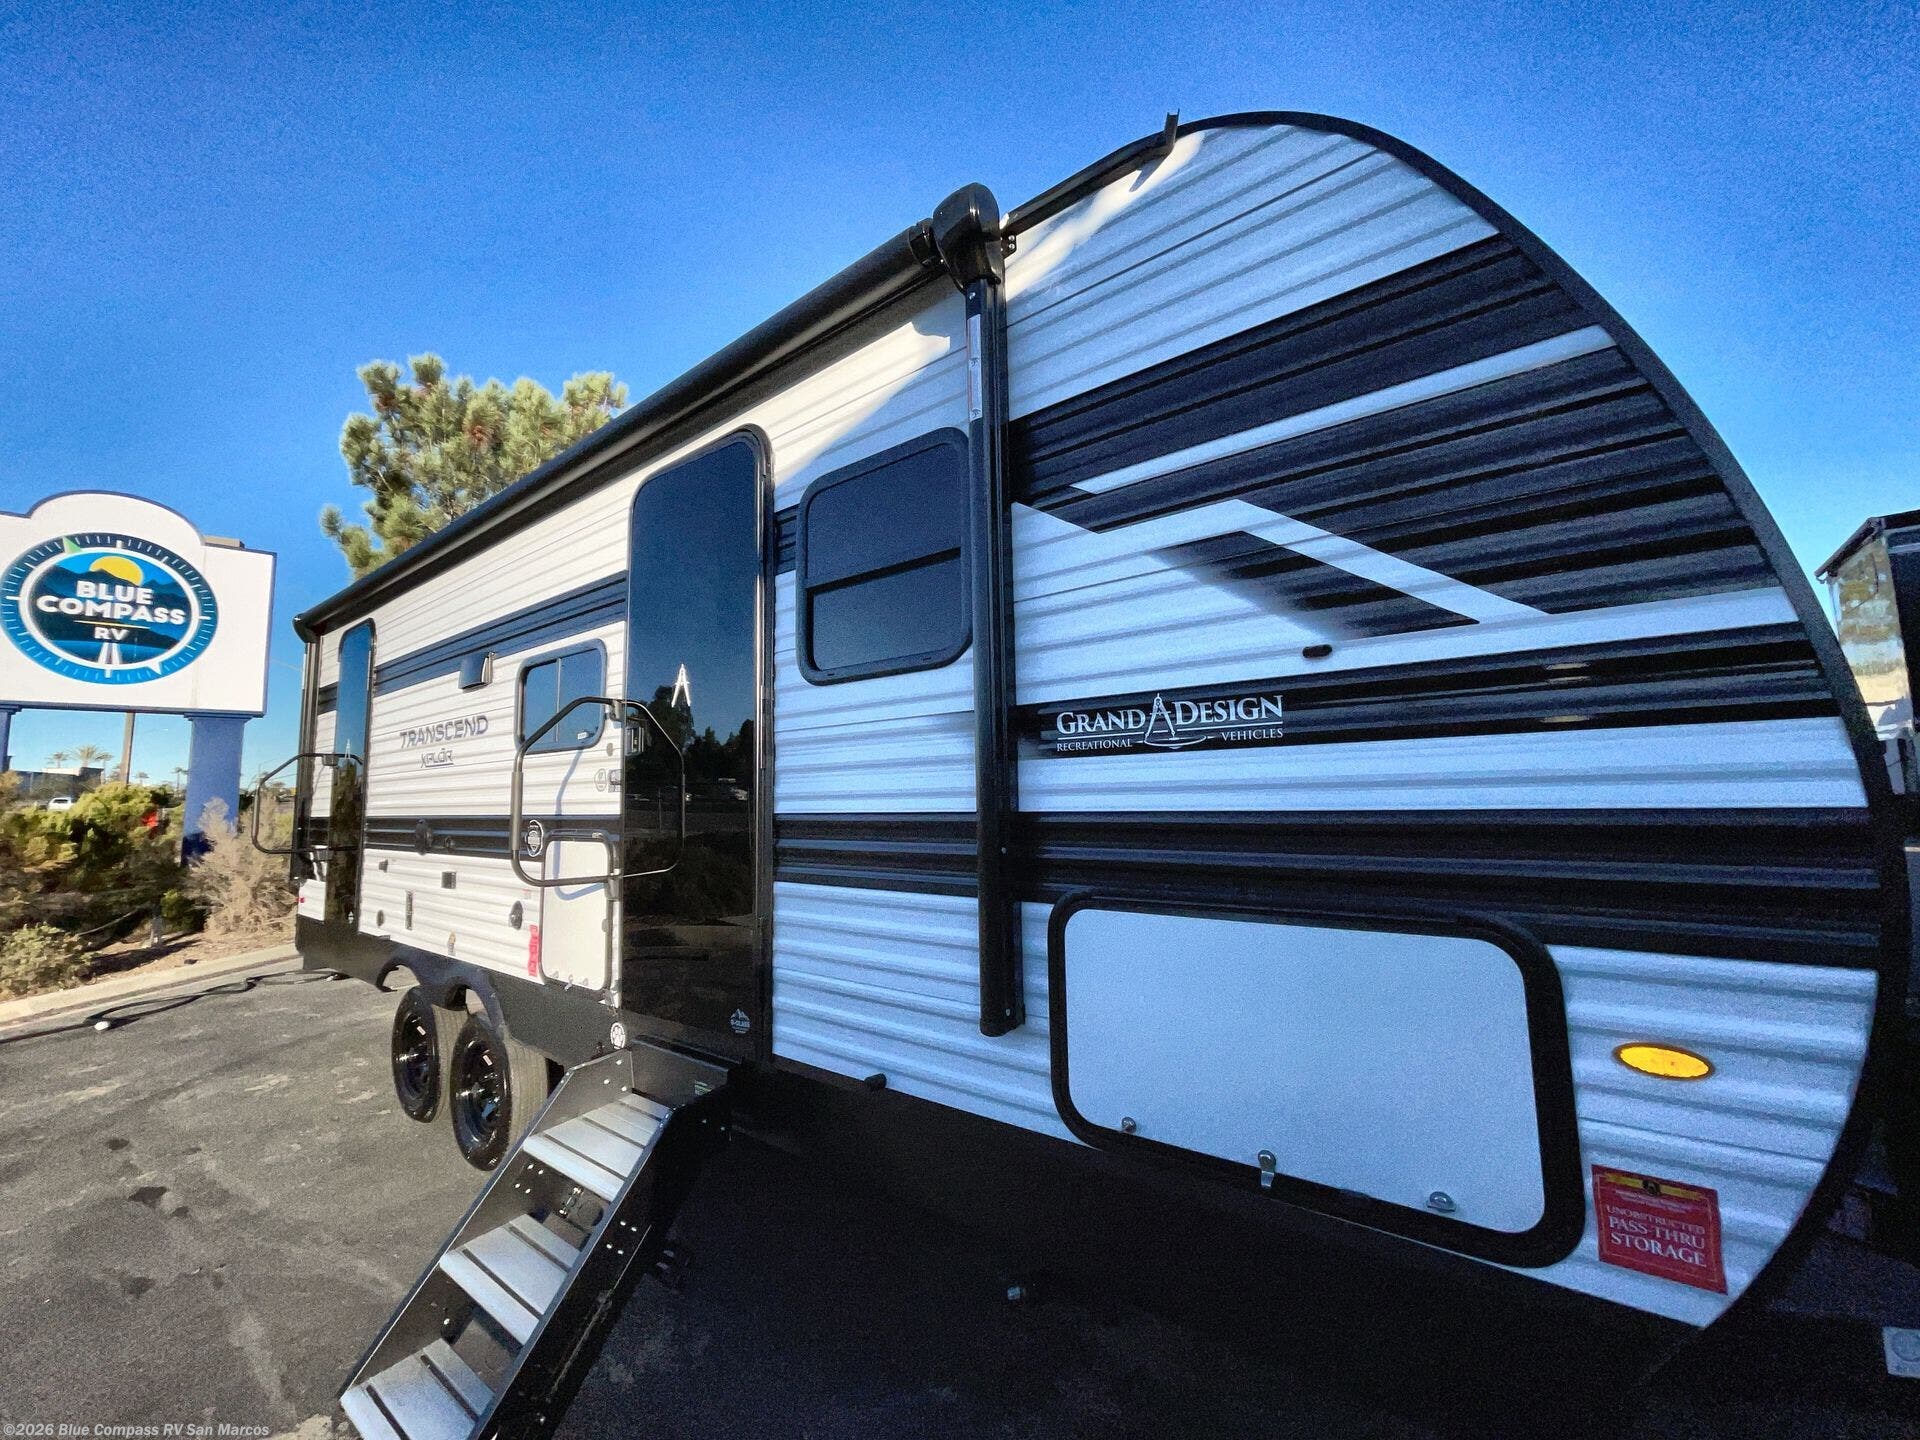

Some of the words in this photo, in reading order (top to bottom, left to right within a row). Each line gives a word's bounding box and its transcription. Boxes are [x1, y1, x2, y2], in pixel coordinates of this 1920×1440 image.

[76, 580, 153, 605] BLUE
[36, 595, 186, 626] COMPASS
[94, 626, 129, 641] RV
[1056, 709, 1145, 735] GRAND
[1172, 695, 1283, 726] DESIGN
[400, 714, 488, 749] TRANSCEND
[1056, 738, 1133, 752] RECREATIONAL
[1221, 728, 1284, 742] VEHICLES
[1606, 1204, 1705, 1235] UNOBSTRUCTED
[1609, 1215, 1705, 1250] PASS-THRU
[1611, 1232, 1707, 1268] STORAGE
